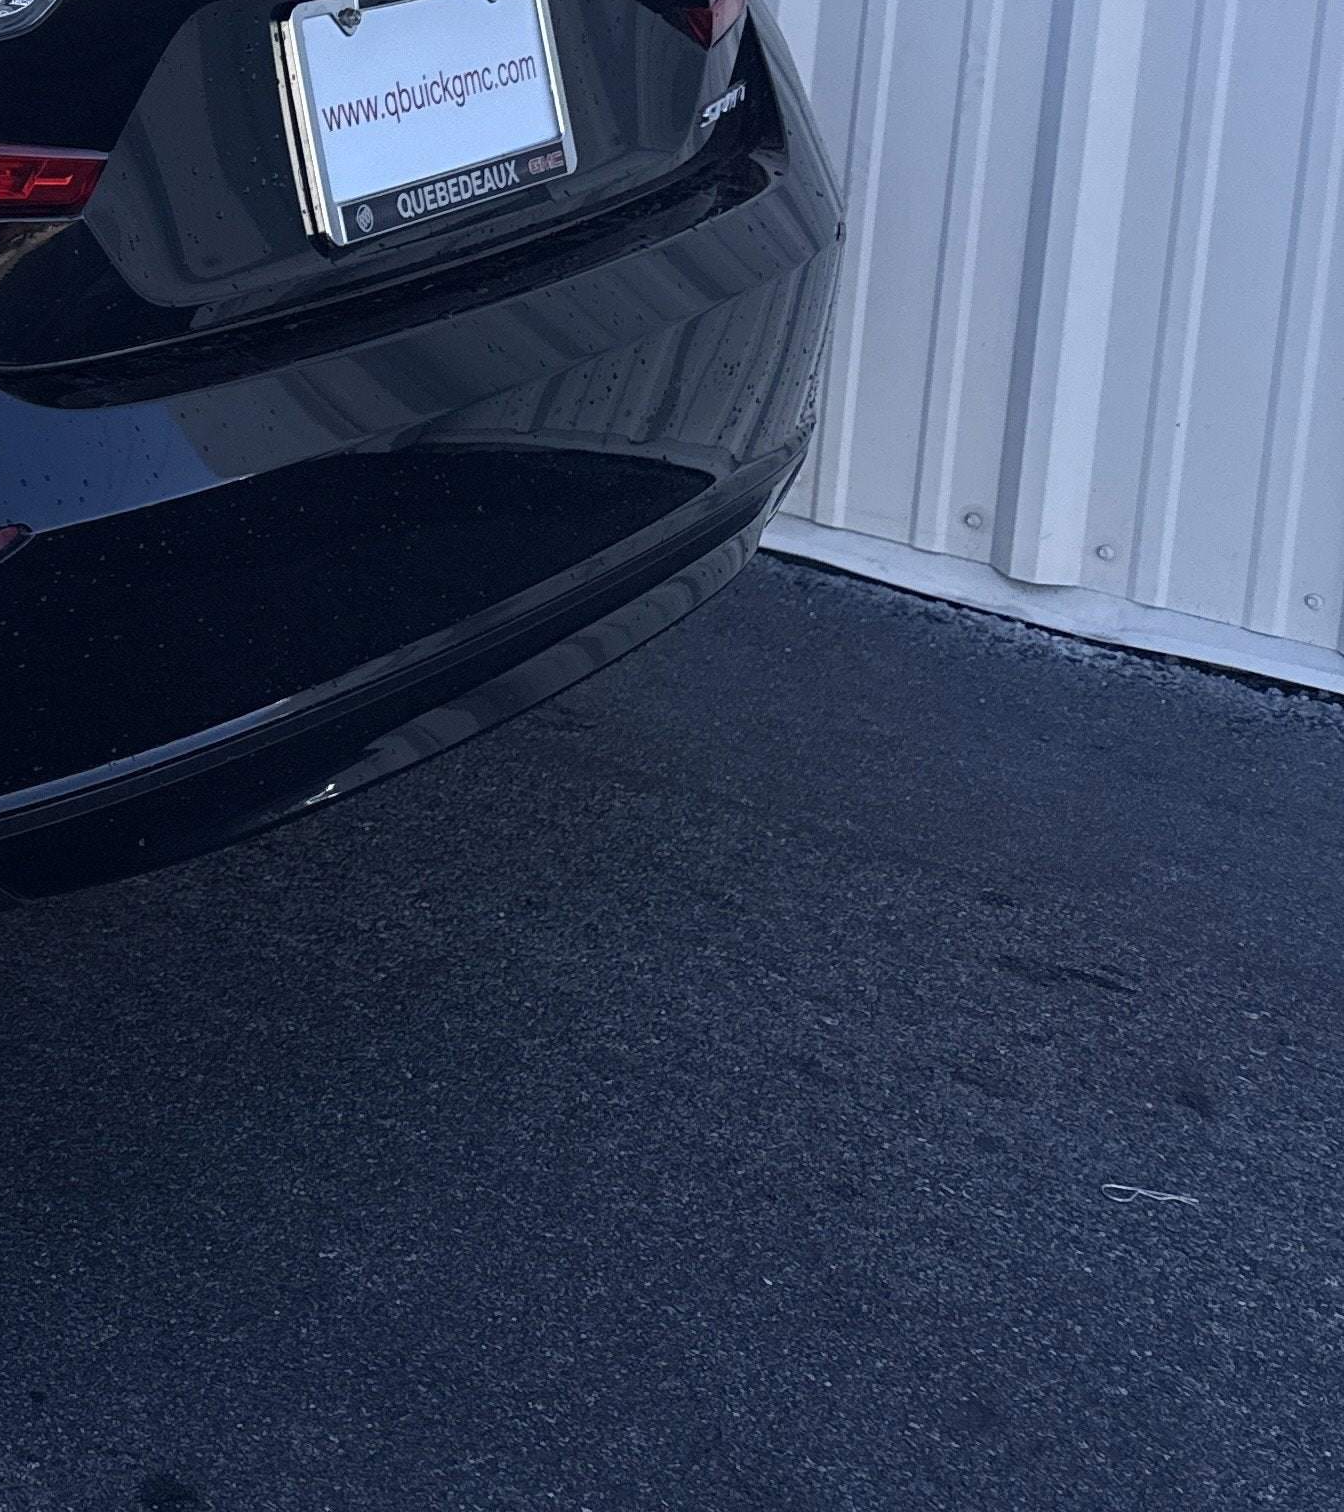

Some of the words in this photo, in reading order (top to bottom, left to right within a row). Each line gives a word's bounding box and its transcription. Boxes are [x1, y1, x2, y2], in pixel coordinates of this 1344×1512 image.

[321, 54, 538, 133] www.qbuickgmc.com
[396, 159, 521, 219] QUEBEDEAUX
[527, 149, 565, 175] GMC
